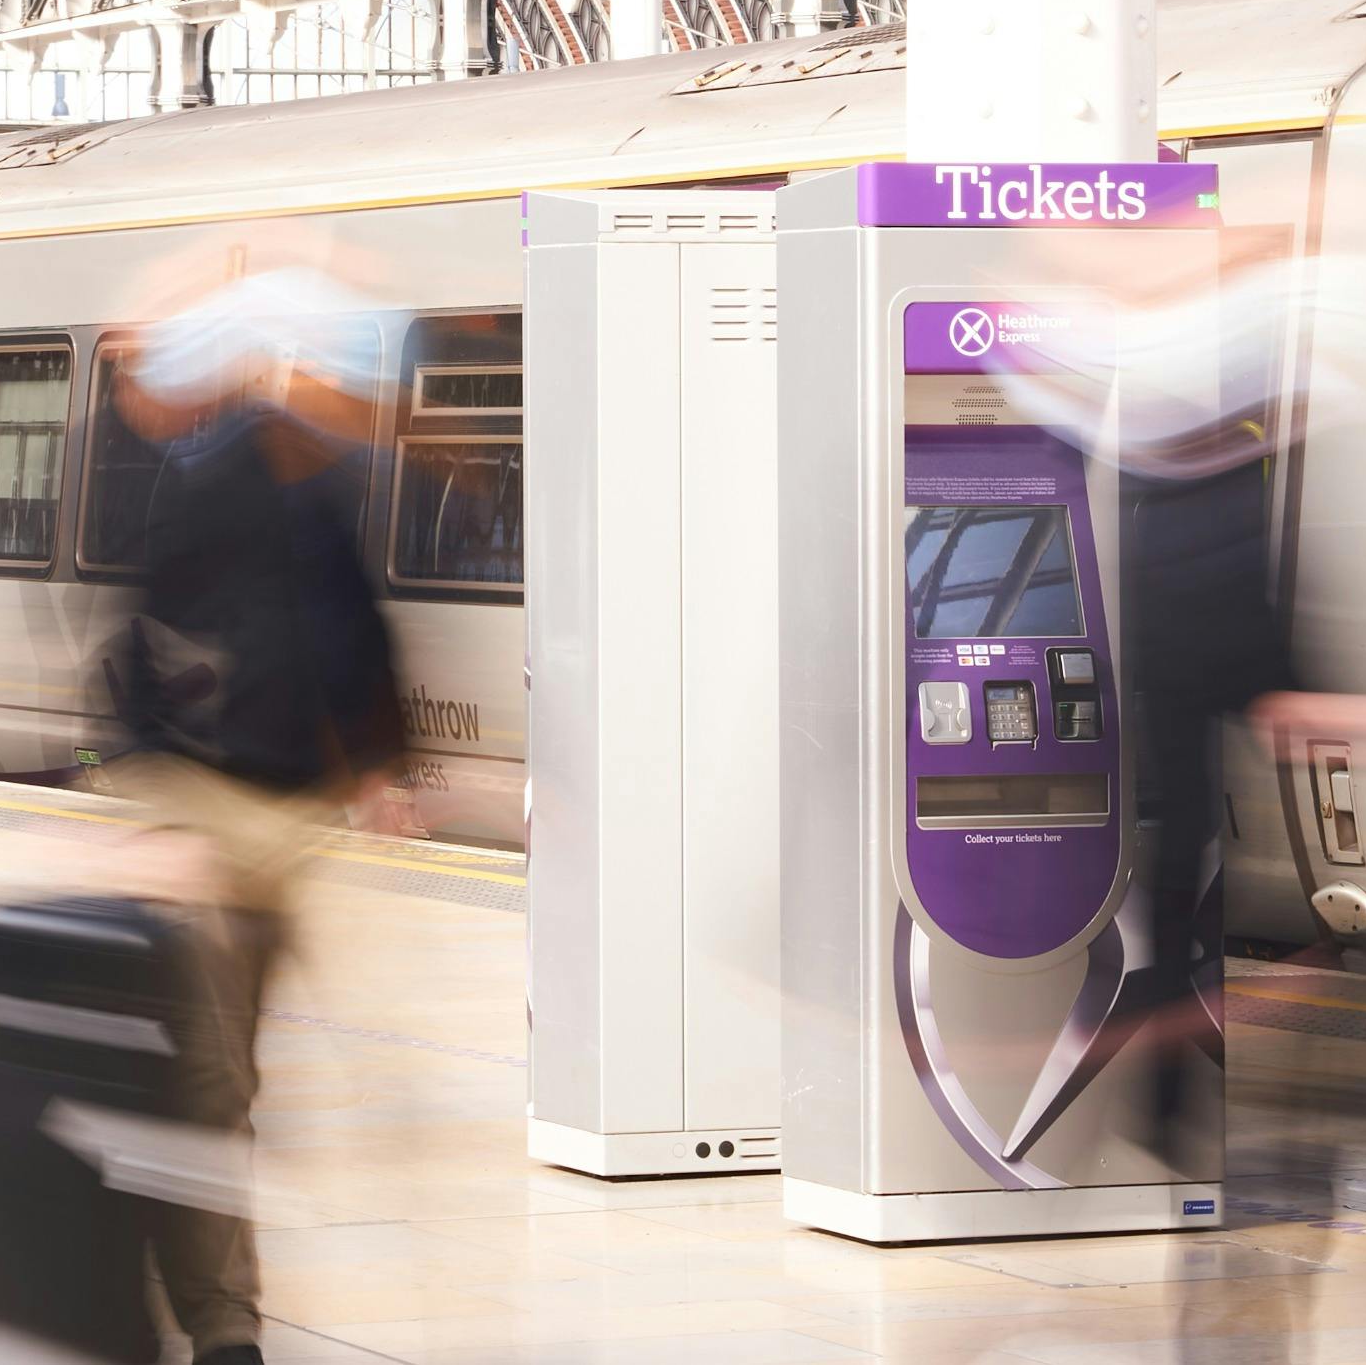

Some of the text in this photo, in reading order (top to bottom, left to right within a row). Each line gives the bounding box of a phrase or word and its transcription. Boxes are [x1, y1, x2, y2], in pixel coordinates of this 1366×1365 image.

[935, 164, 1146, 220] Tickets
[997, 314, 1072, 330] Heathrow
[997, 330, 1041, 345] Express
[401, 684, 479, 742] athrow
[398, 761, 450, 794] press
[965, 833, 1062, 845] Collect your tickets here
